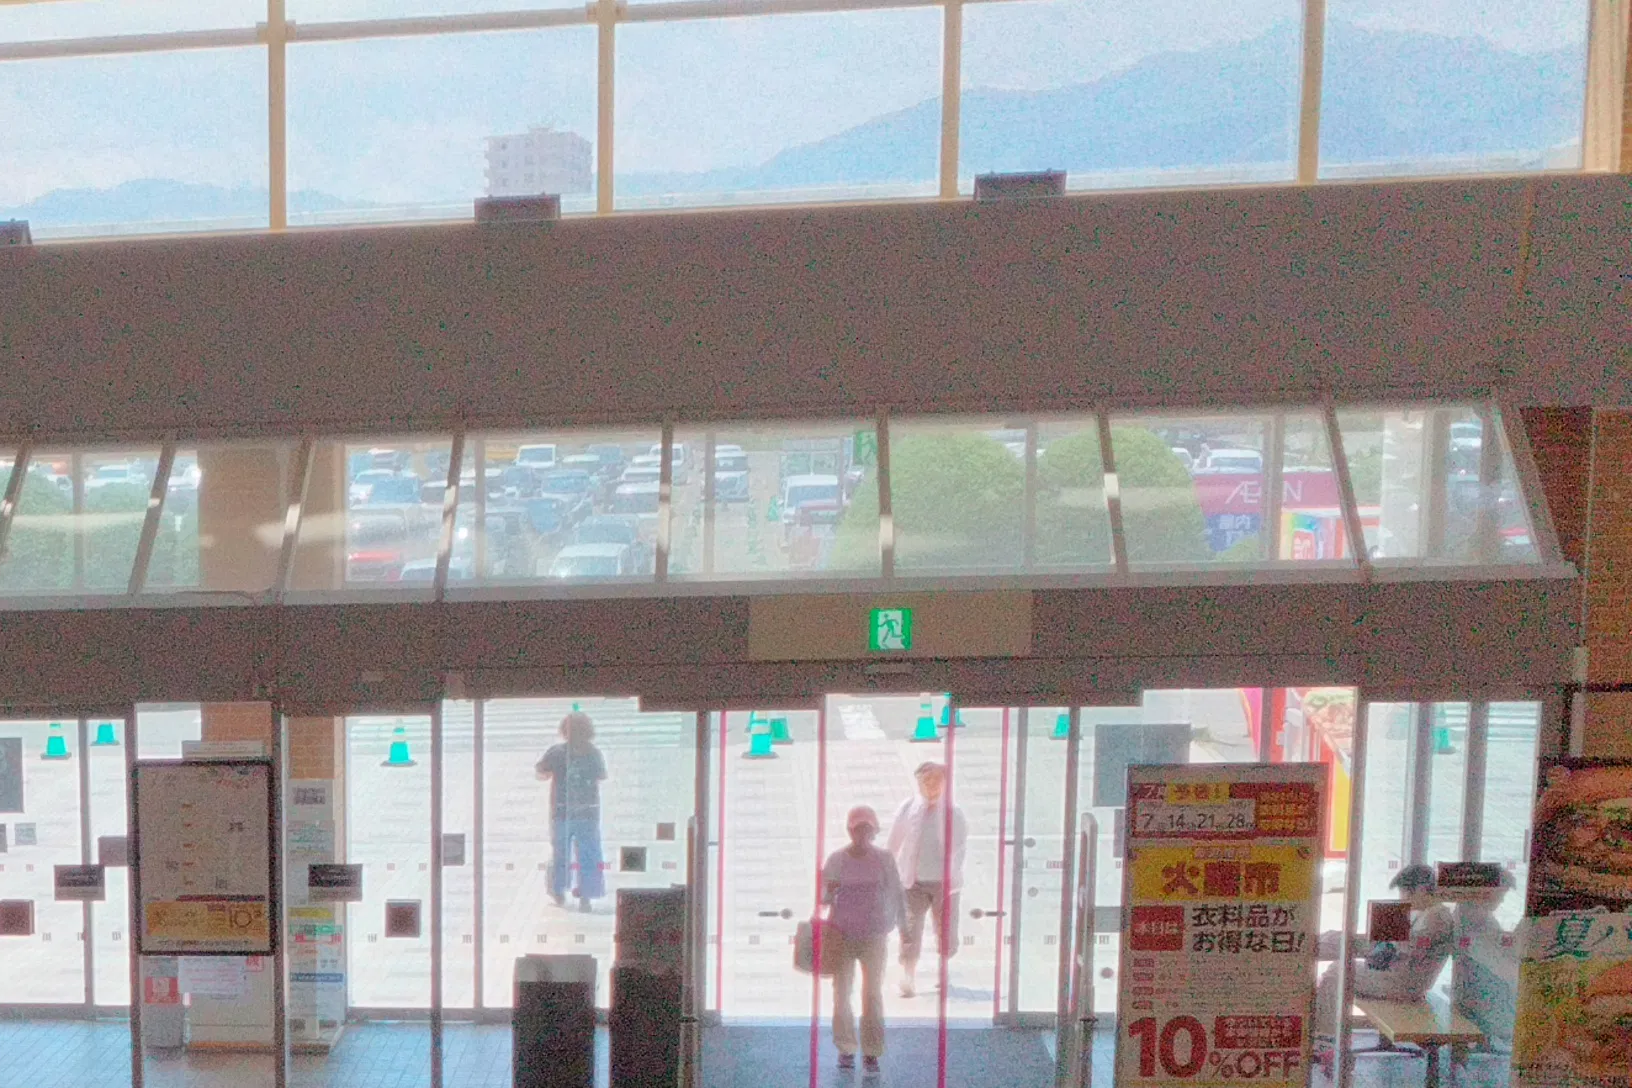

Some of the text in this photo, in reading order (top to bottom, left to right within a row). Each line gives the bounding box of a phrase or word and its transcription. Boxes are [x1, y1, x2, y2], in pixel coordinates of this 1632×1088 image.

[1225, 480, 1303, 504] AEN
[1191, 903, 1296, 928] 衣料品が
